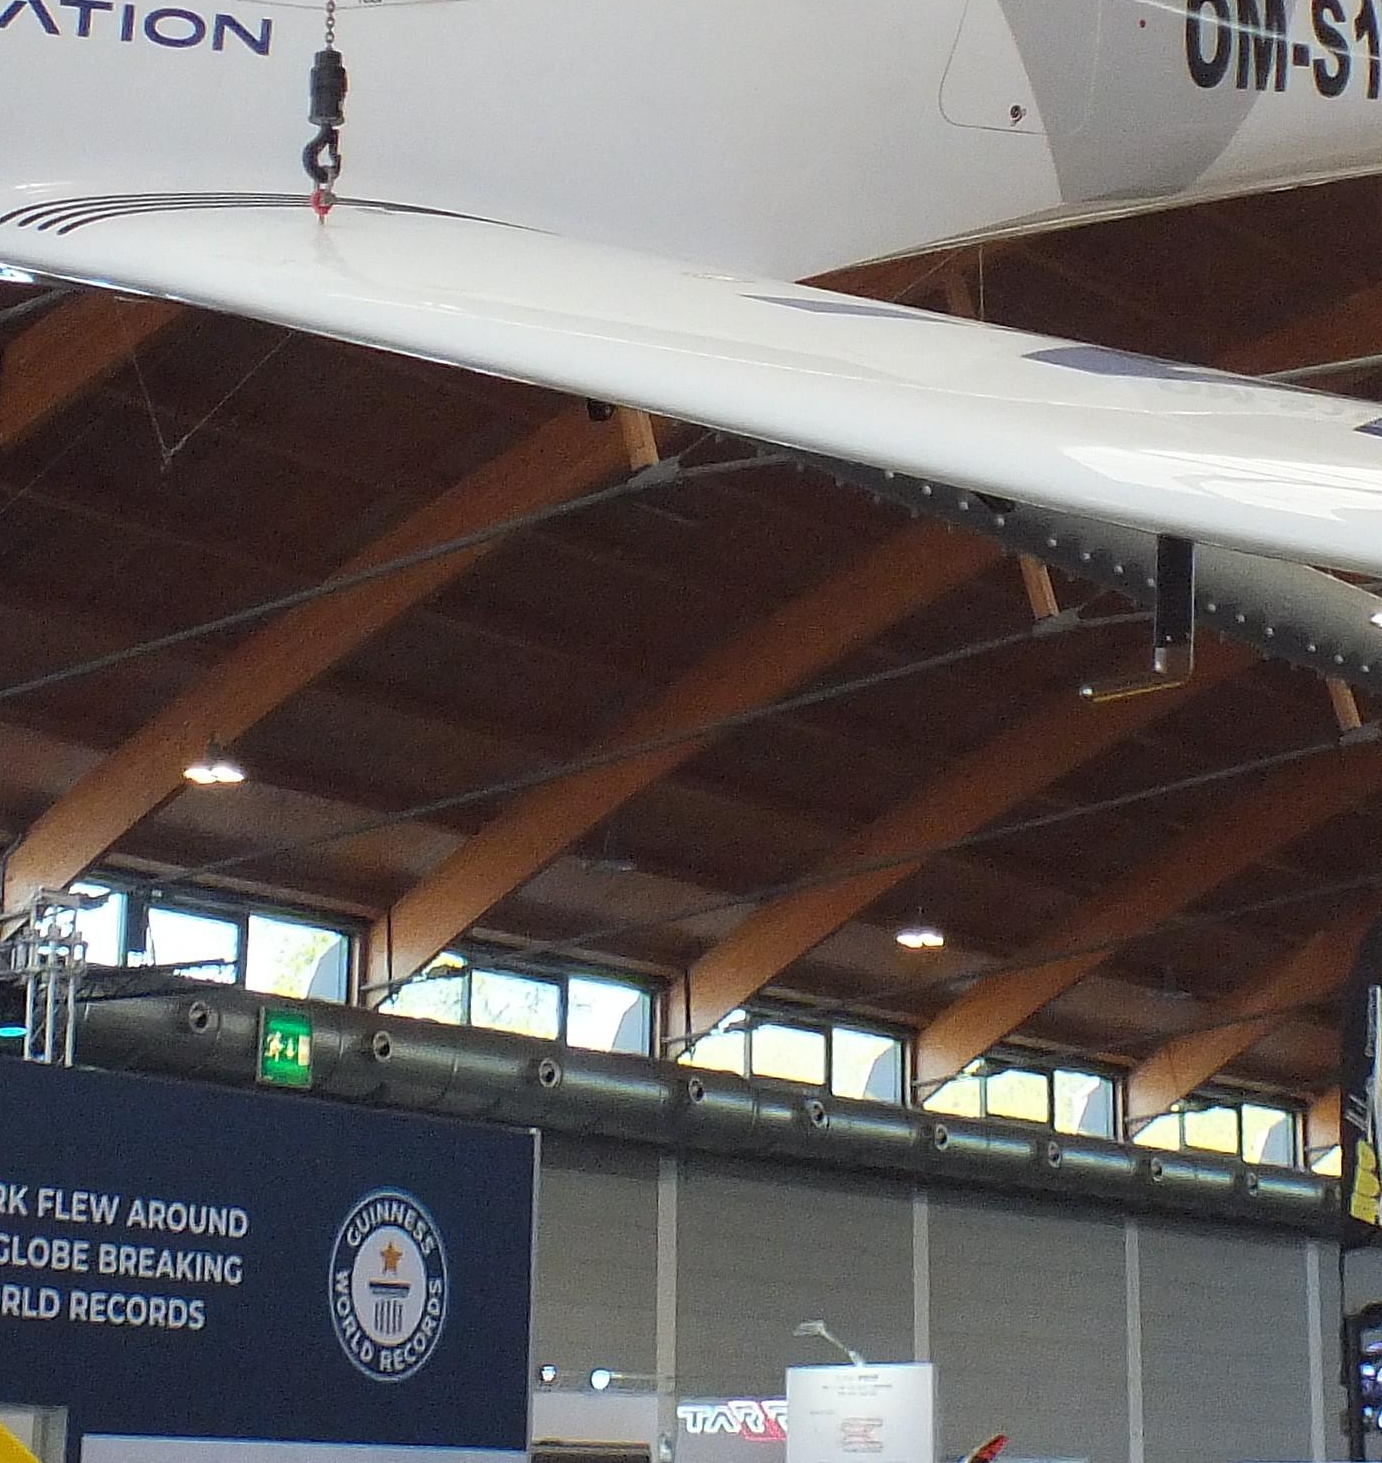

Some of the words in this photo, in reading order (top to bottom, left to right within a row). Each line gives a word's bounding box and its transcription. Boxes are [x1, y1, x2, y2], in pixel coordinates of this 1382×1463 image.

[37, 1187, 120, 1226] FLEW
[126, 1198, 250, 1239] AROUND
[346, 1200, 437, 1258] GUINNESS
[97, 1242, 244, 1286] BREAKING
[68, 1290, 206, 1331] RECORDS
[334, 1269, 375, 1364] WORLD
[379, 1278, 442, 1373] RECORDS
